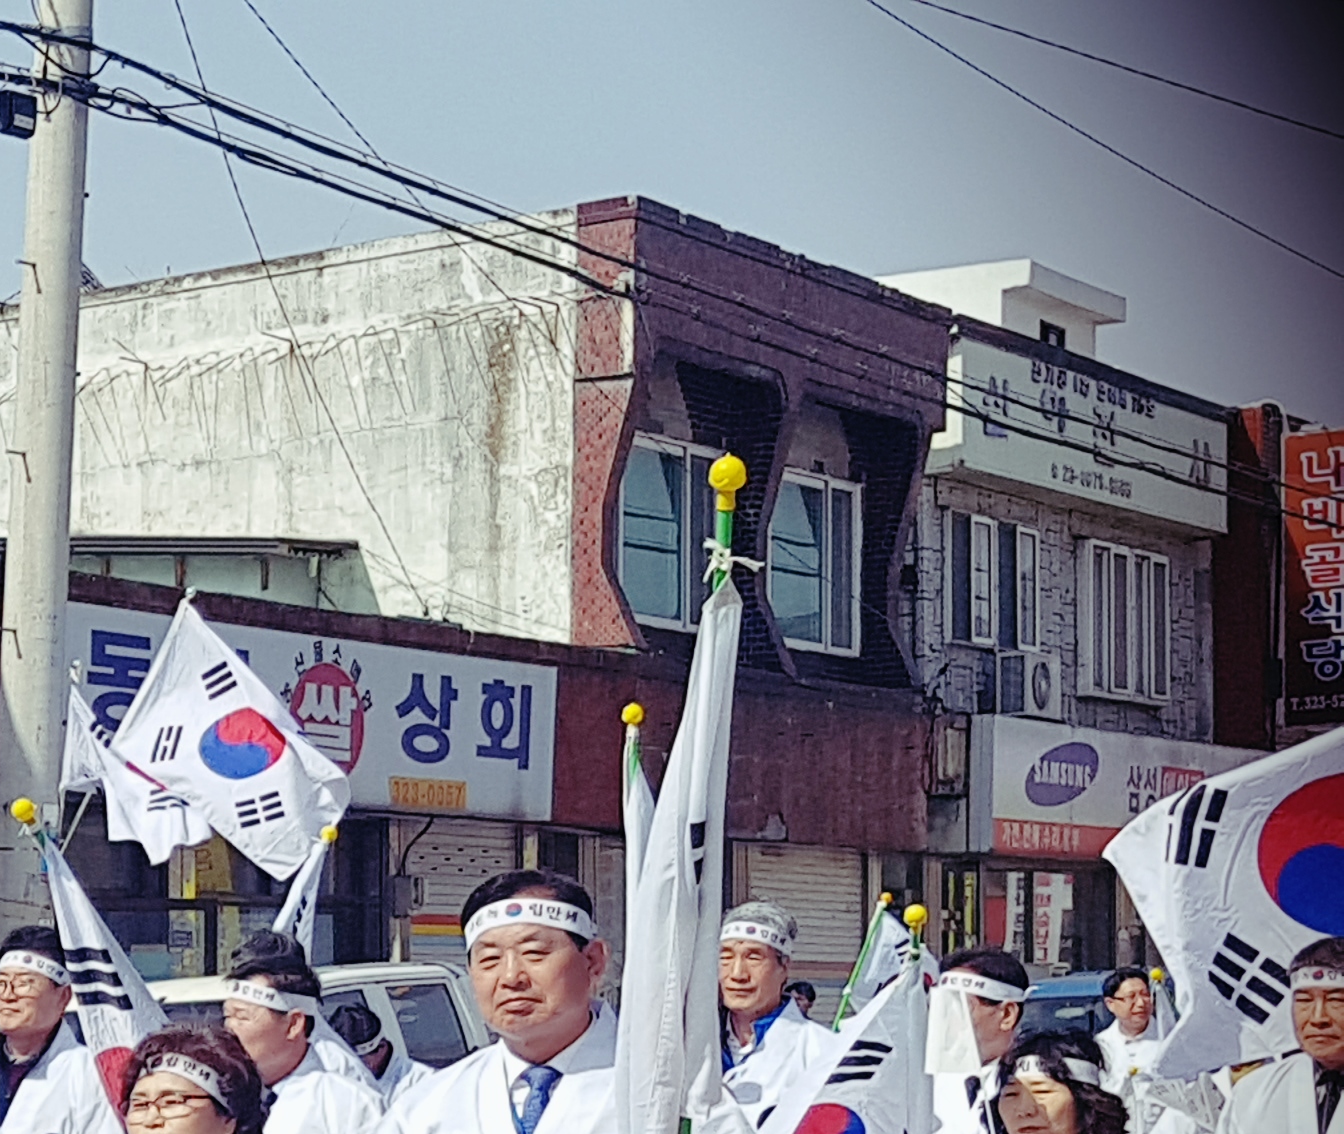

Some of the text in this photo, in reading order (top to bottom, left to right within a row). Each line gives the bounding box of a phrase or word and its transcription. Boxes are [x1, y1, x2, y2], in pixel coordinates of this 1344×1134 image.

[296, 681, 357, 762] 쌀
[395, 673, 531, 770] 상회
[1032, 759, 1093, 788] SAMSUNG
